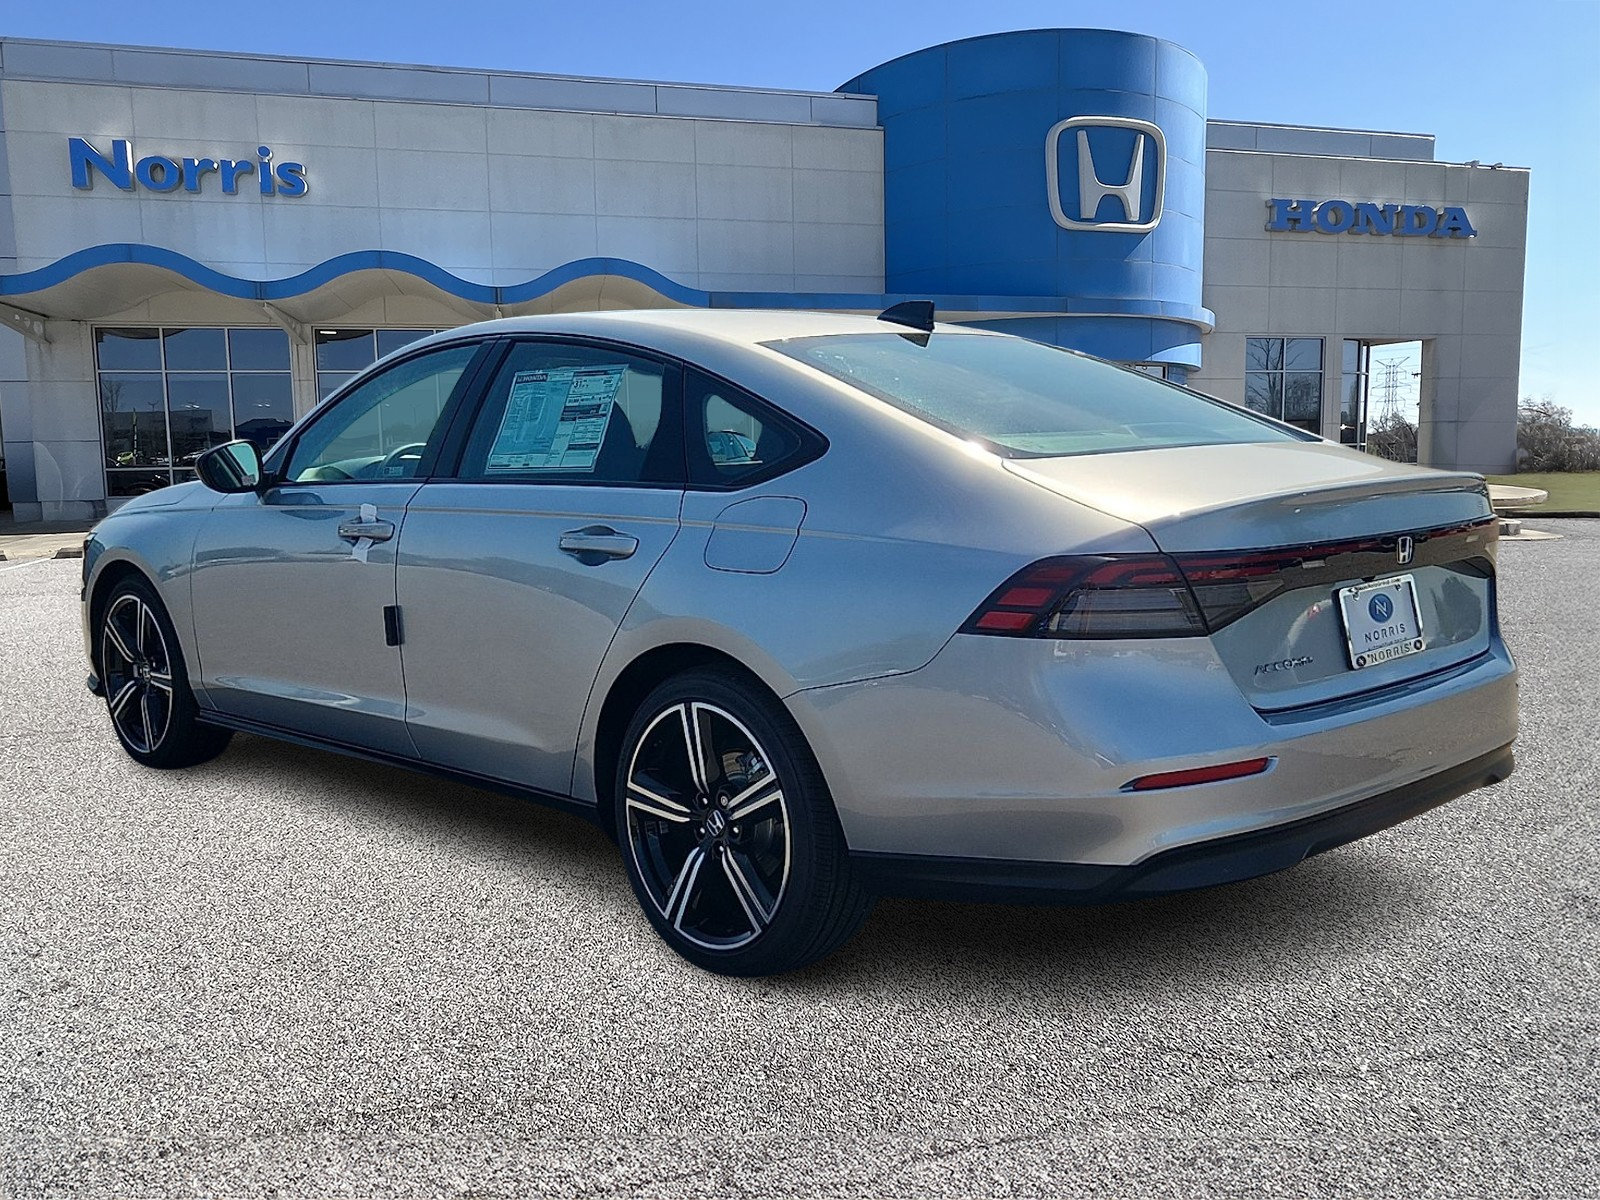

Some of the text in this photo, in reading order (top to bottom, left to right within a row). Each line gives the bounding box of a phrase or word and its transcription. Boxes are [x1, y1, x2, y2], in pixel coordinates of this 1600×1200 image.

[68, 138, 308, 197] Norris
[1266, 198, 1477, 238] HONDA
[1364, 623, 1406, 643] NORRIS
[1254, 656, 1313, 676] ACCO
